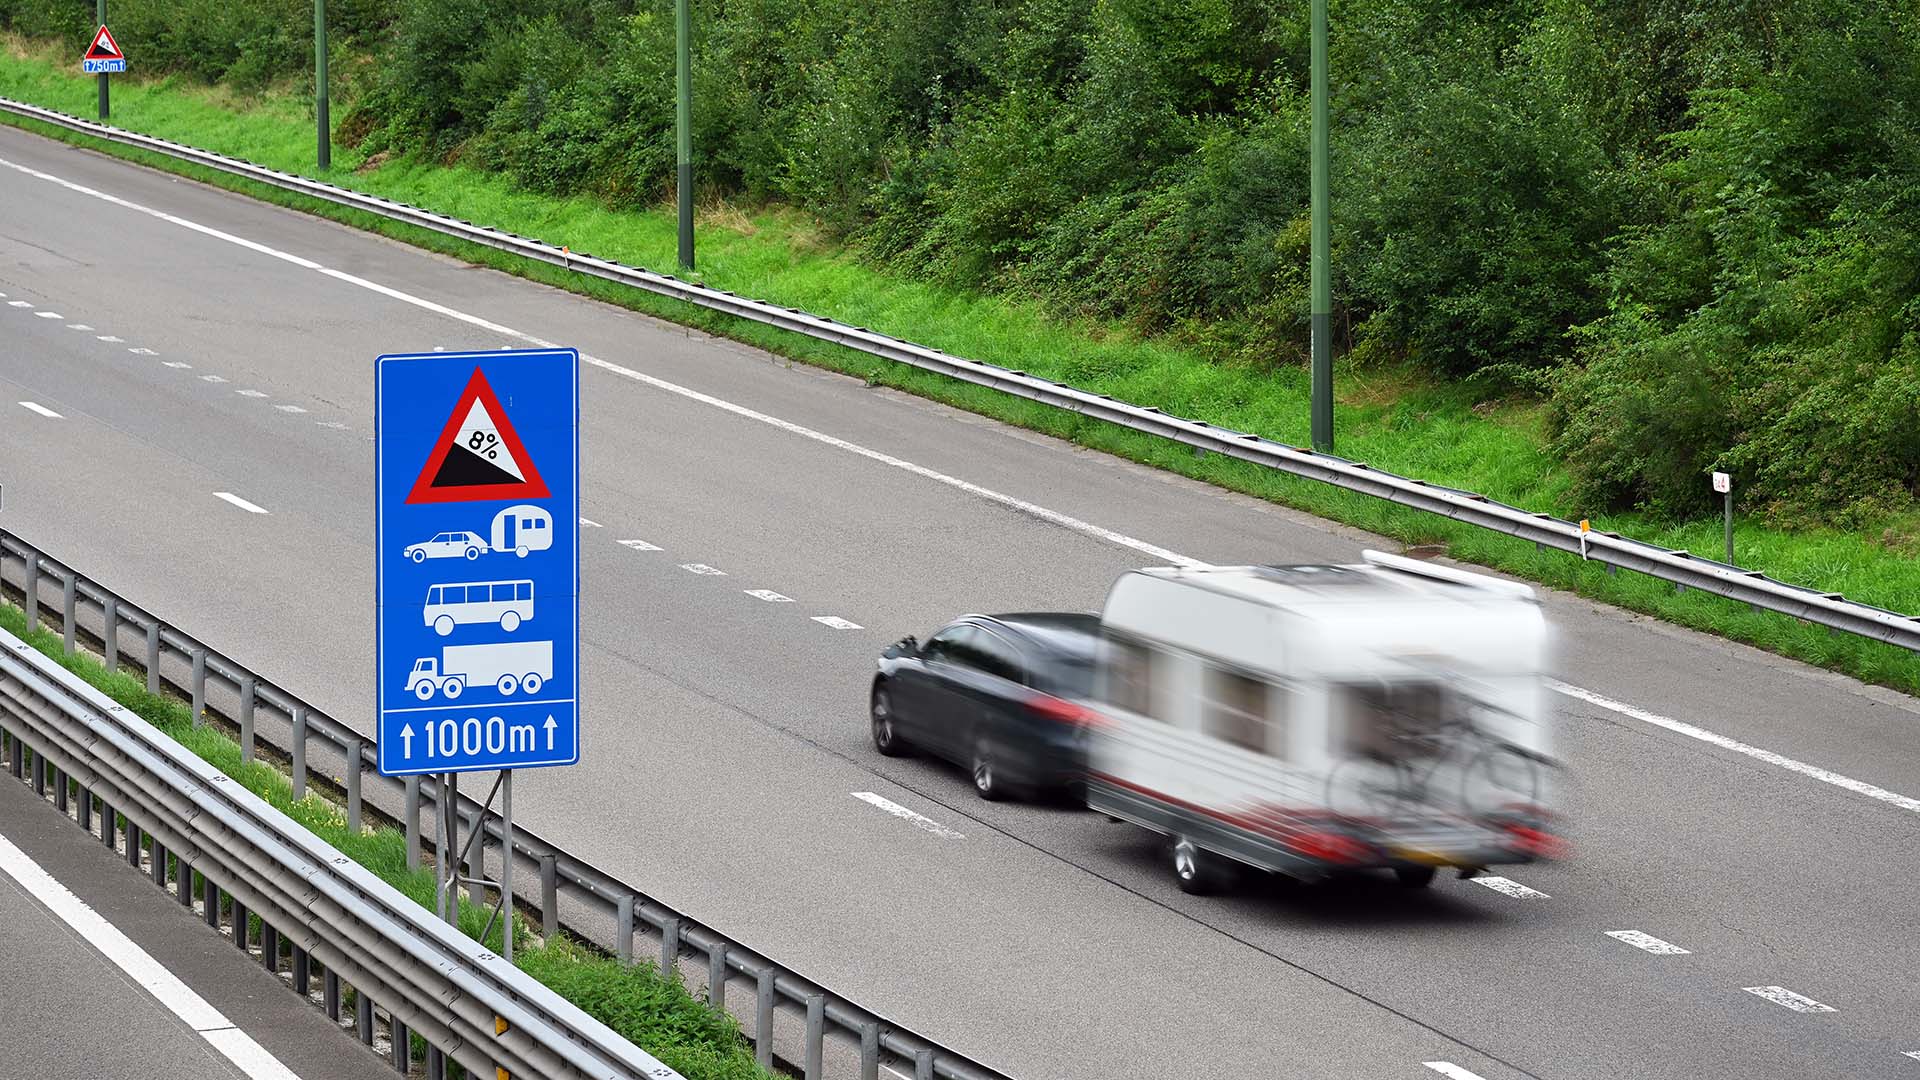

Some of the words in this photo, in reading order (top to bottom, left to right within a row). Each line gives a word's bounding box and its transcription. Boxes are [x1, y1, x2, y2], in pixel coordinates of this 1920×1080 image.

[90, 60, 118, 72] 750m
[468, 430, 500, 460] 8%
[425, 716, 535, 758] 1000m
